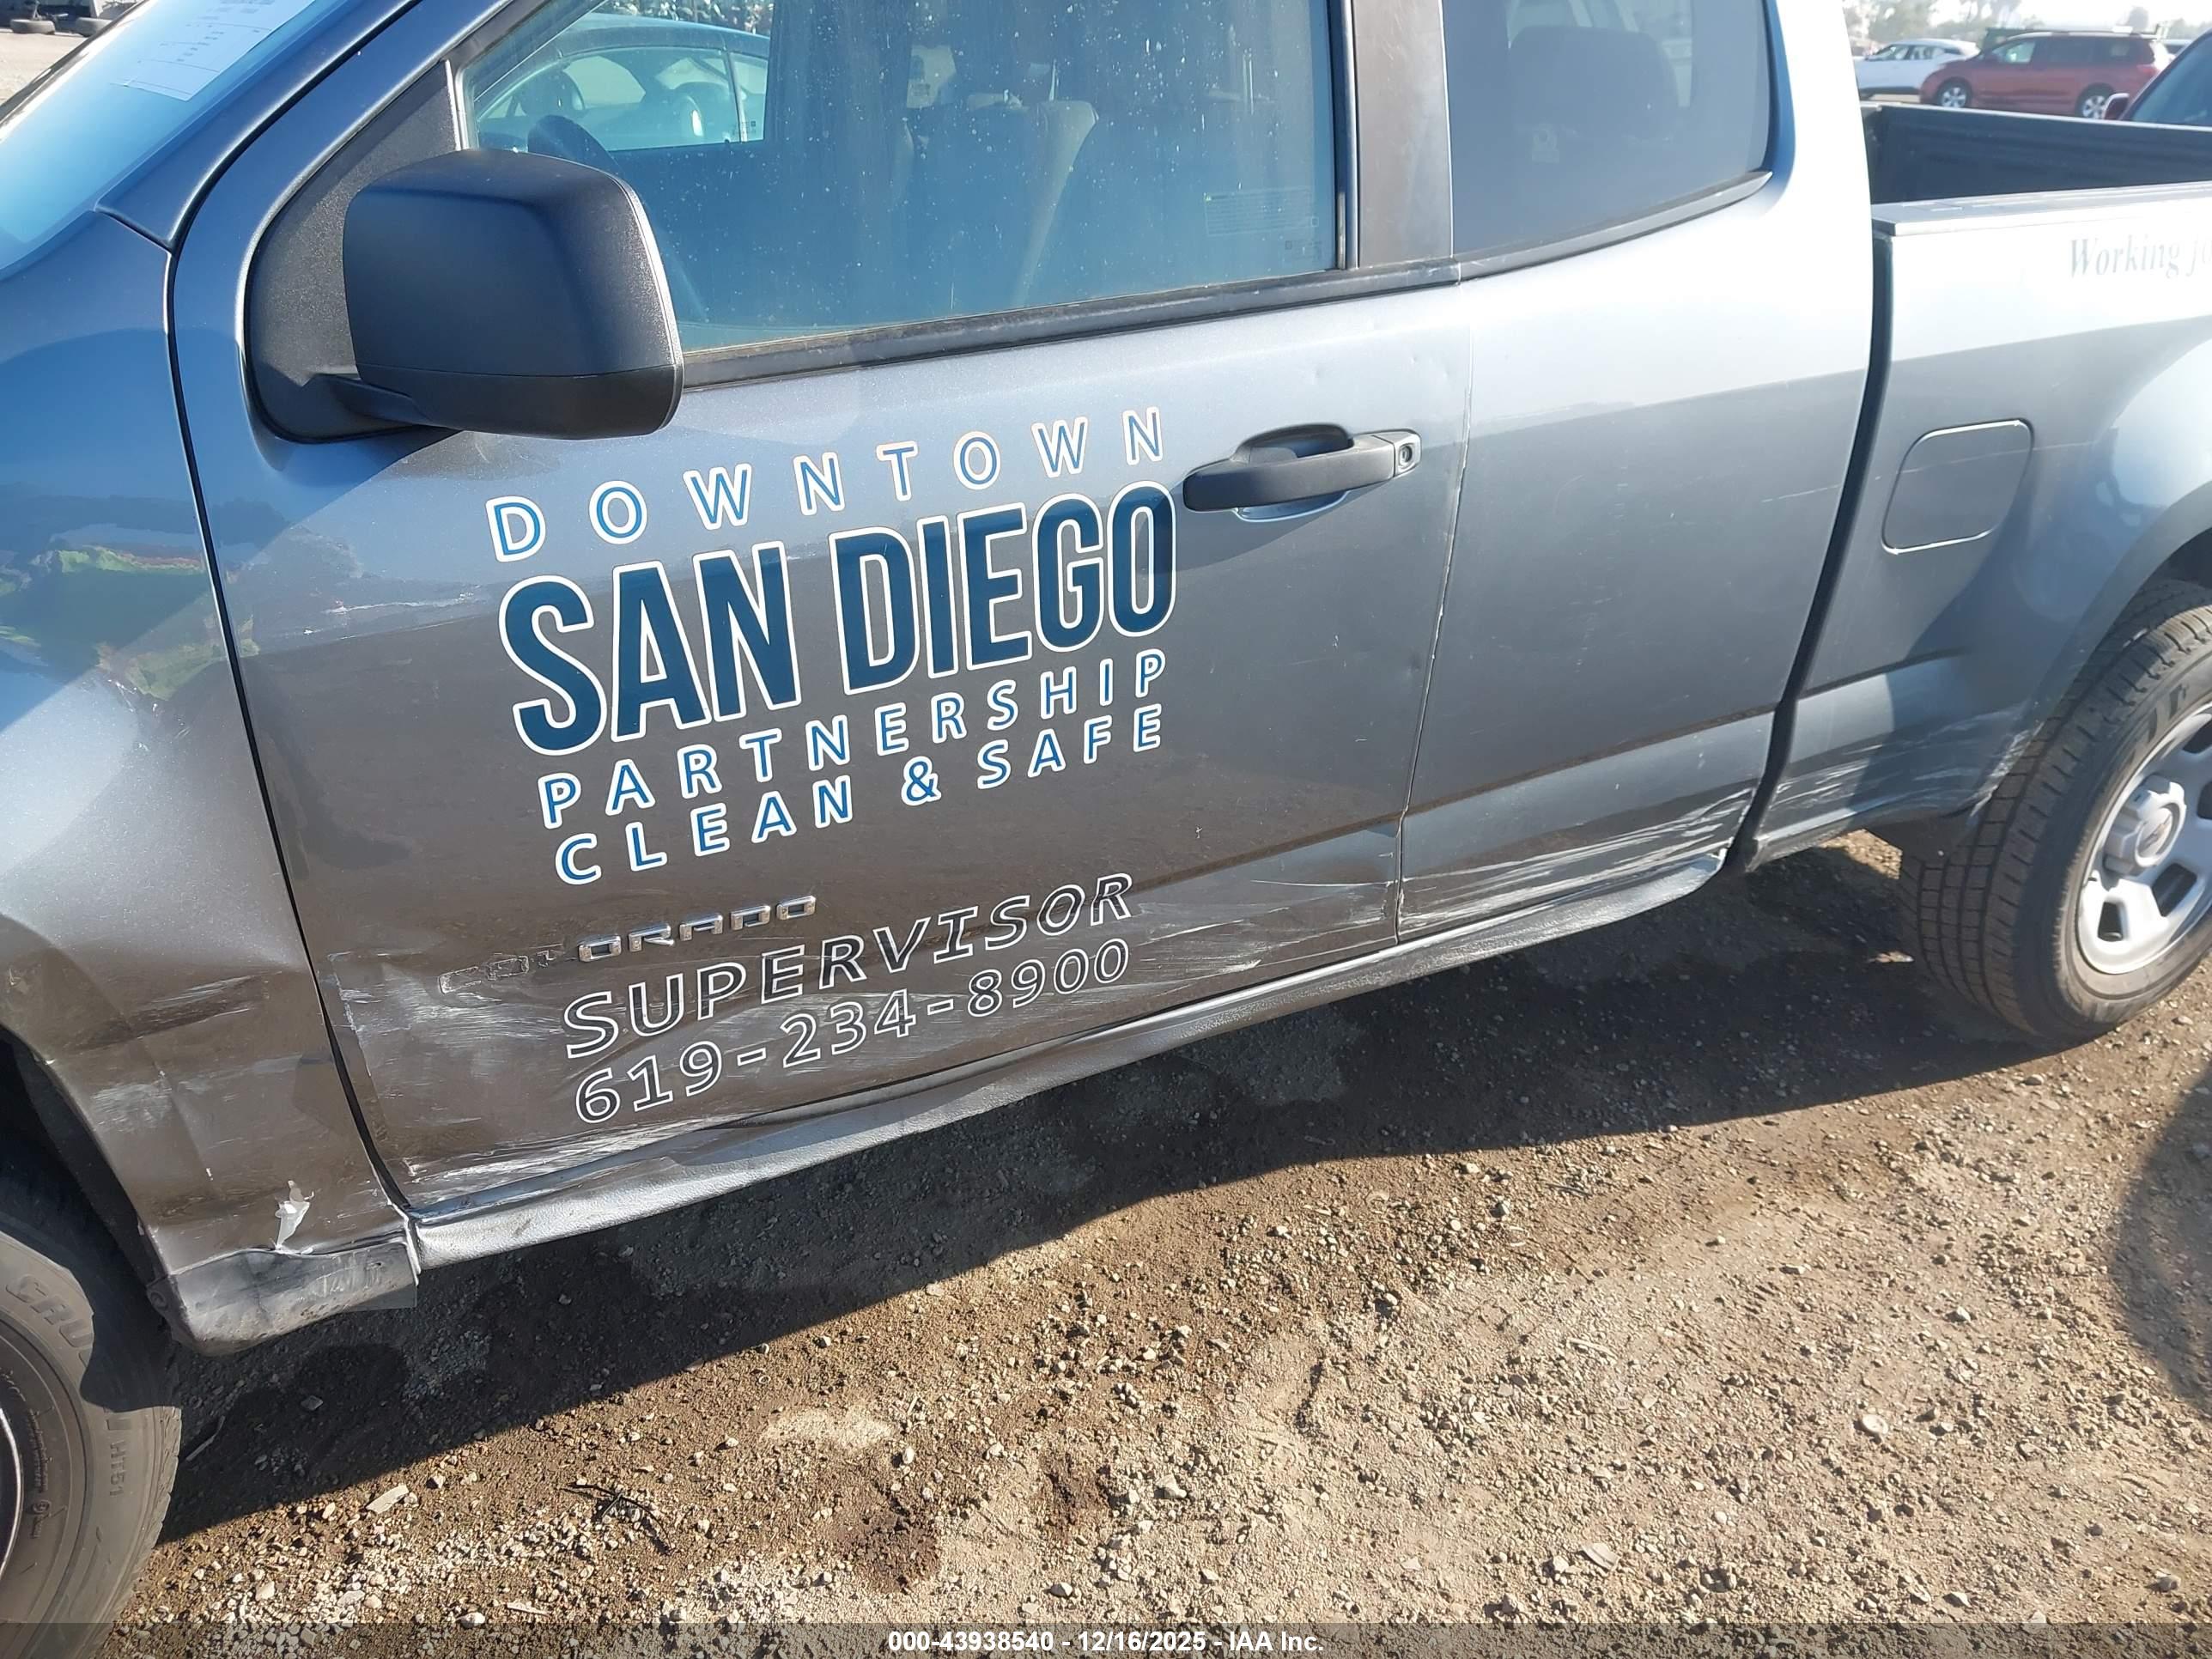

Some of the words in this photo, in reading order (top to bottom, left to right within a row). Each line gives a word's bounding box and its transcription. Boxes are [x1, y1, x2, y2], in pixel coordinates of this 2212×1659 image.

[2070, 233, 2180, 280] Working
[486, 407, 1163, 562] DOWNTOWN
[499, 541, 801, 756] SAN
[828, 481, 1176, 695] DIEGO
[538, 649, 1165, 830] PARTNERSHIP
[556, 775, 853, 884] CLEAN
[902, 757, 941, 805] &
[977, 704, 1162, 789] SAFE
[439, 895, 816, 994] COORADO
[564, 872, 1132, 1059] SUPERVISOR
[576, 939, 1128, 1123] 619-234-8900
